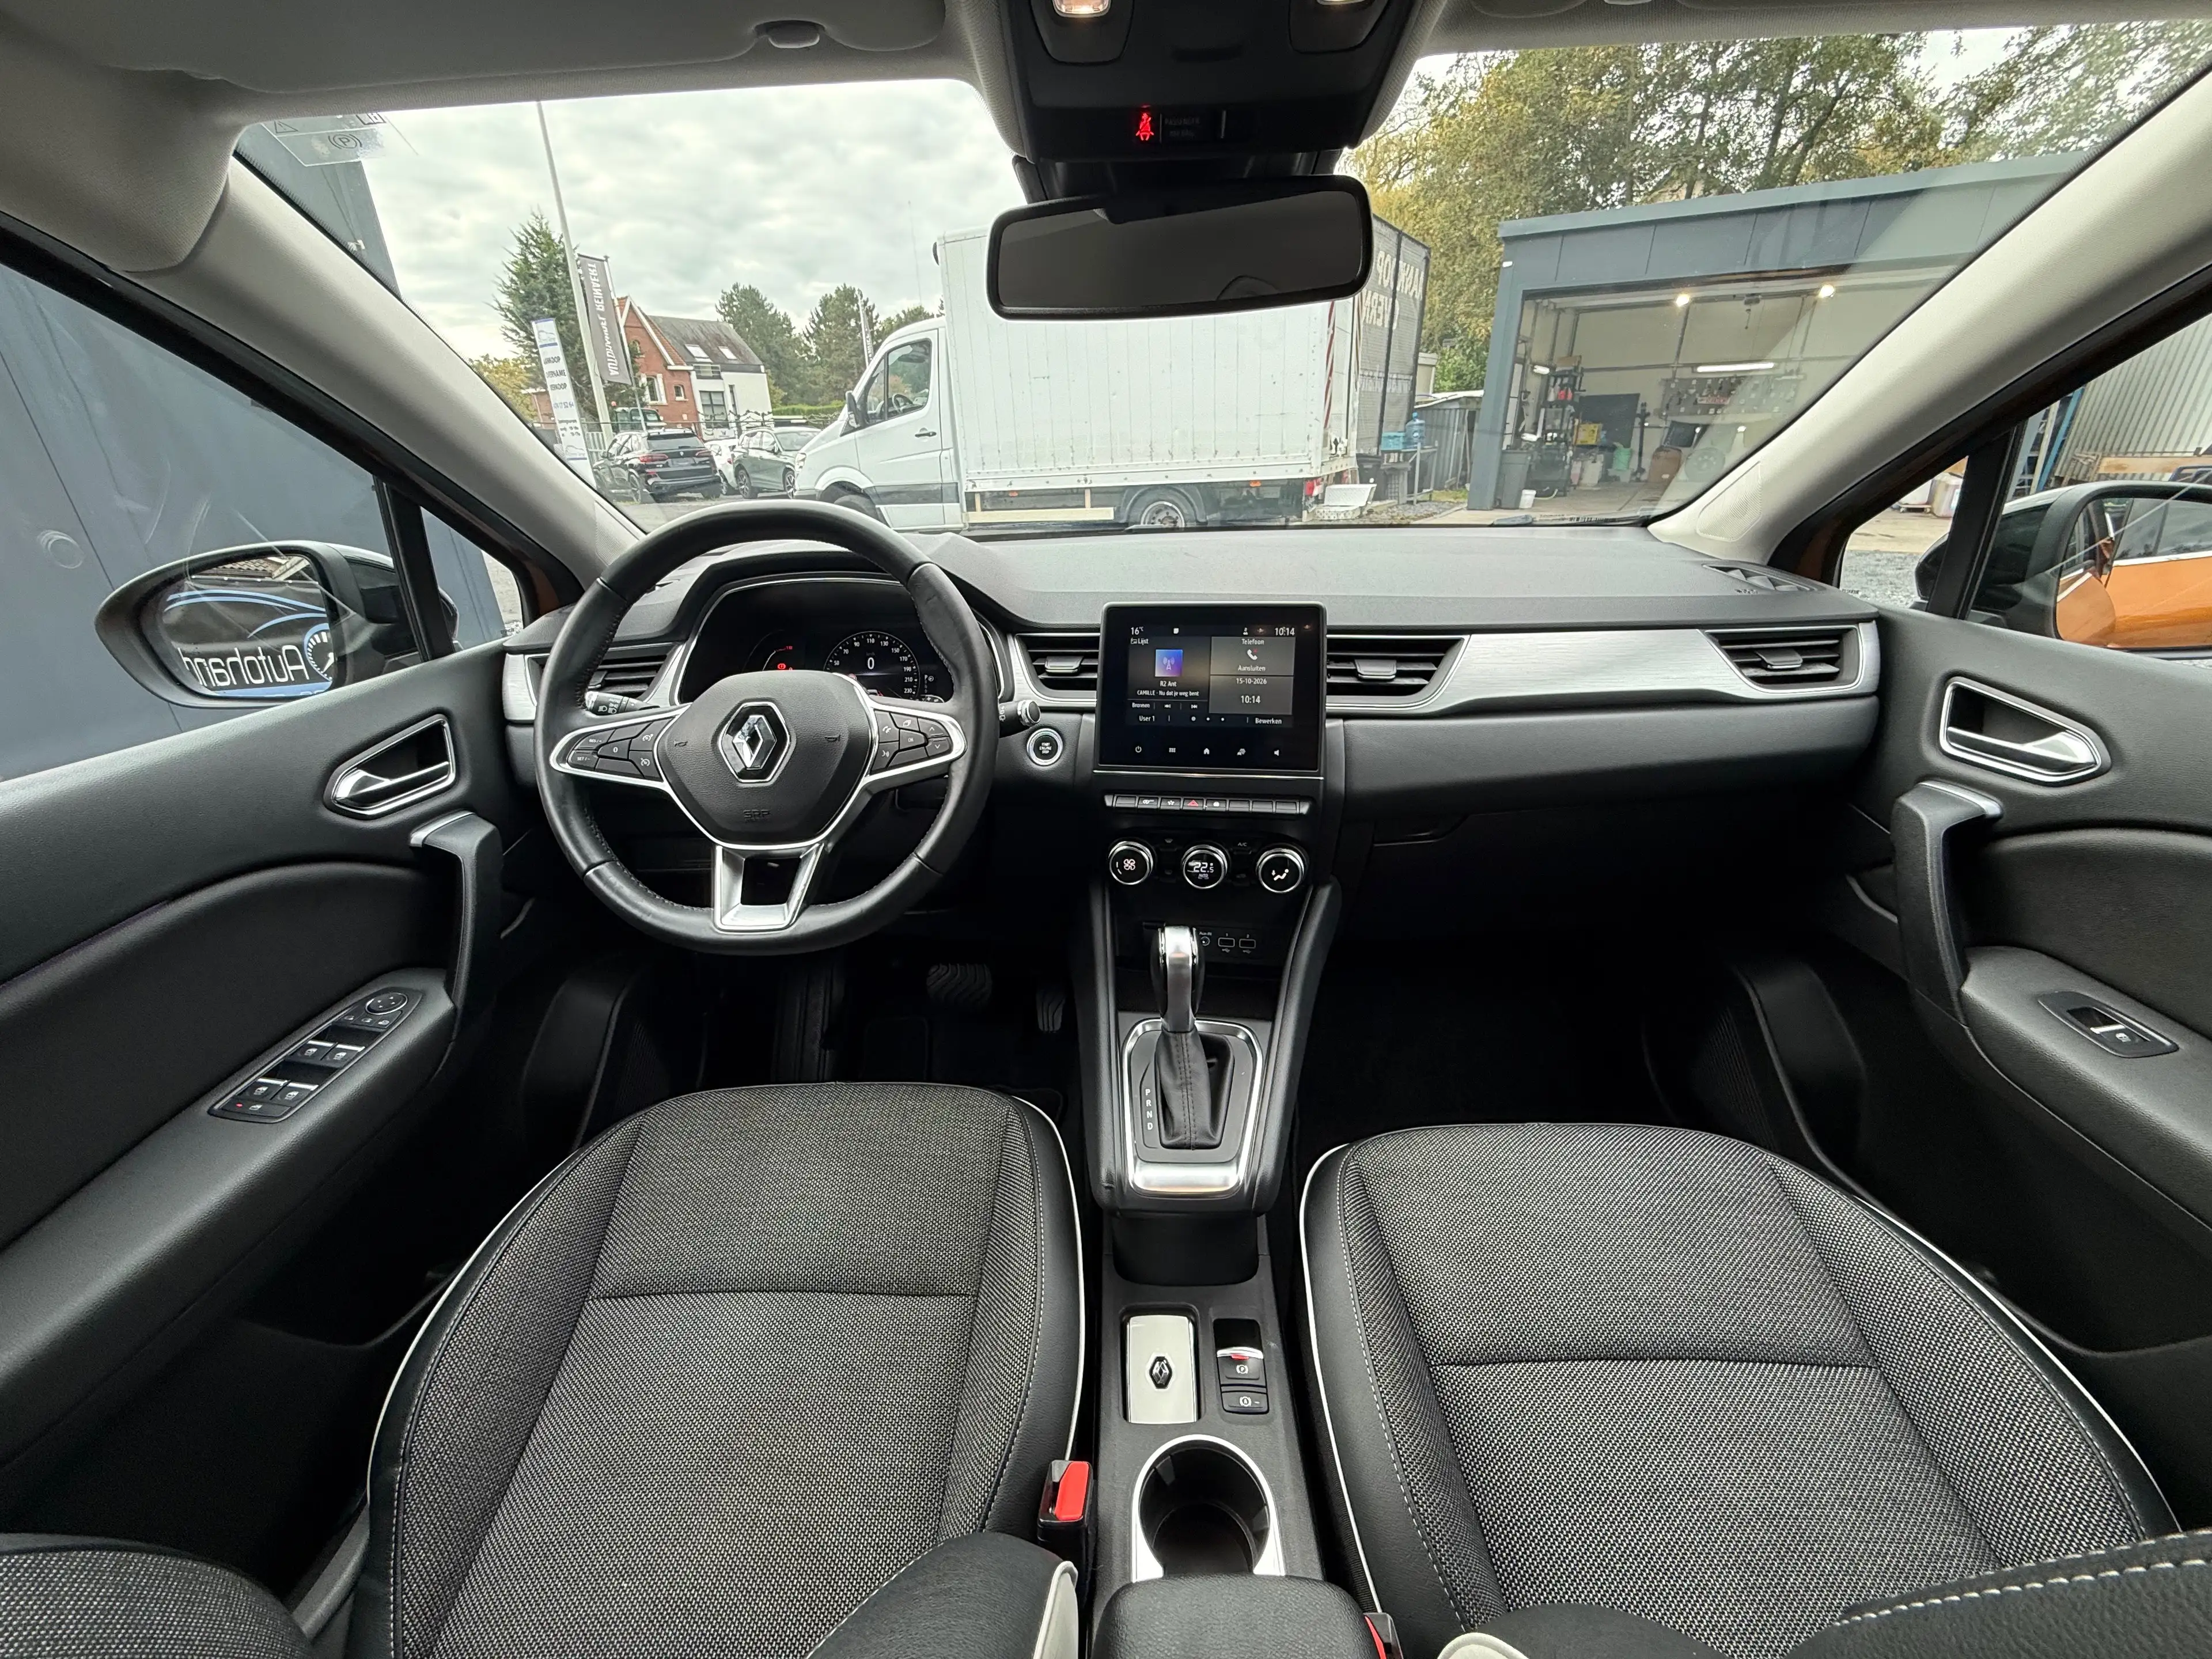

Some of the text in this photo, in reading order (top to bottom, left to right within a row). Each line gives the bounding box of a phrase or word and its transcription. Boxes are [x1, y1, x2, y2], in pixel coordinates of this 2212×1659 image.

[1274, 627, 1295, 636] 10:14
[867, 657, 875, 670] 0
[1240, 695, 1261, 704] 10:14
